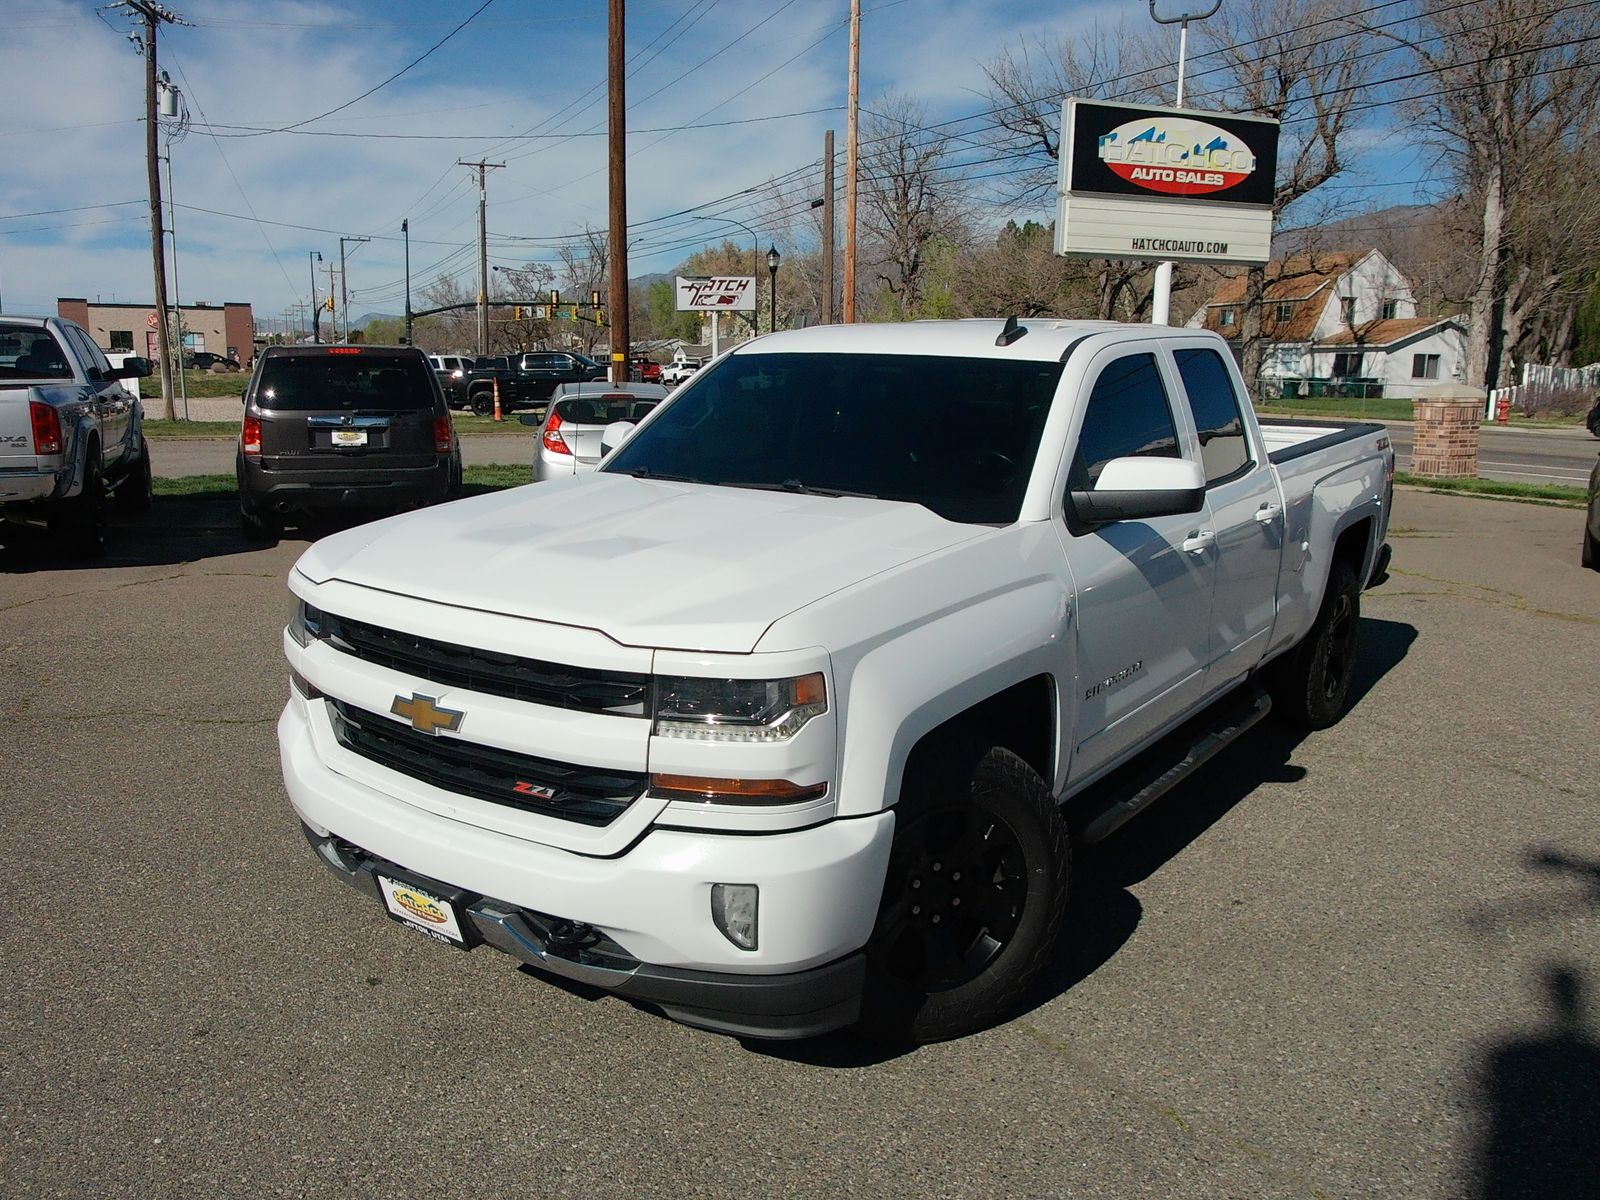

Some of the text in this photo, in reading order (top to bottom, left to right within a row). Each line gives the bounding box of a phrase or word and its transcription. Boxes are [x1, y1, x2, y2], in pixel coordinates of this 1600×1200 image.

[1098, 132, 1256, 174] HATCHCO
[1131, 167, 1224, 186] AUTO SALES
[1132, 238, 1228, 254] HATCHCOAUTO.COM
[512, 781, 556, 799] Z71
